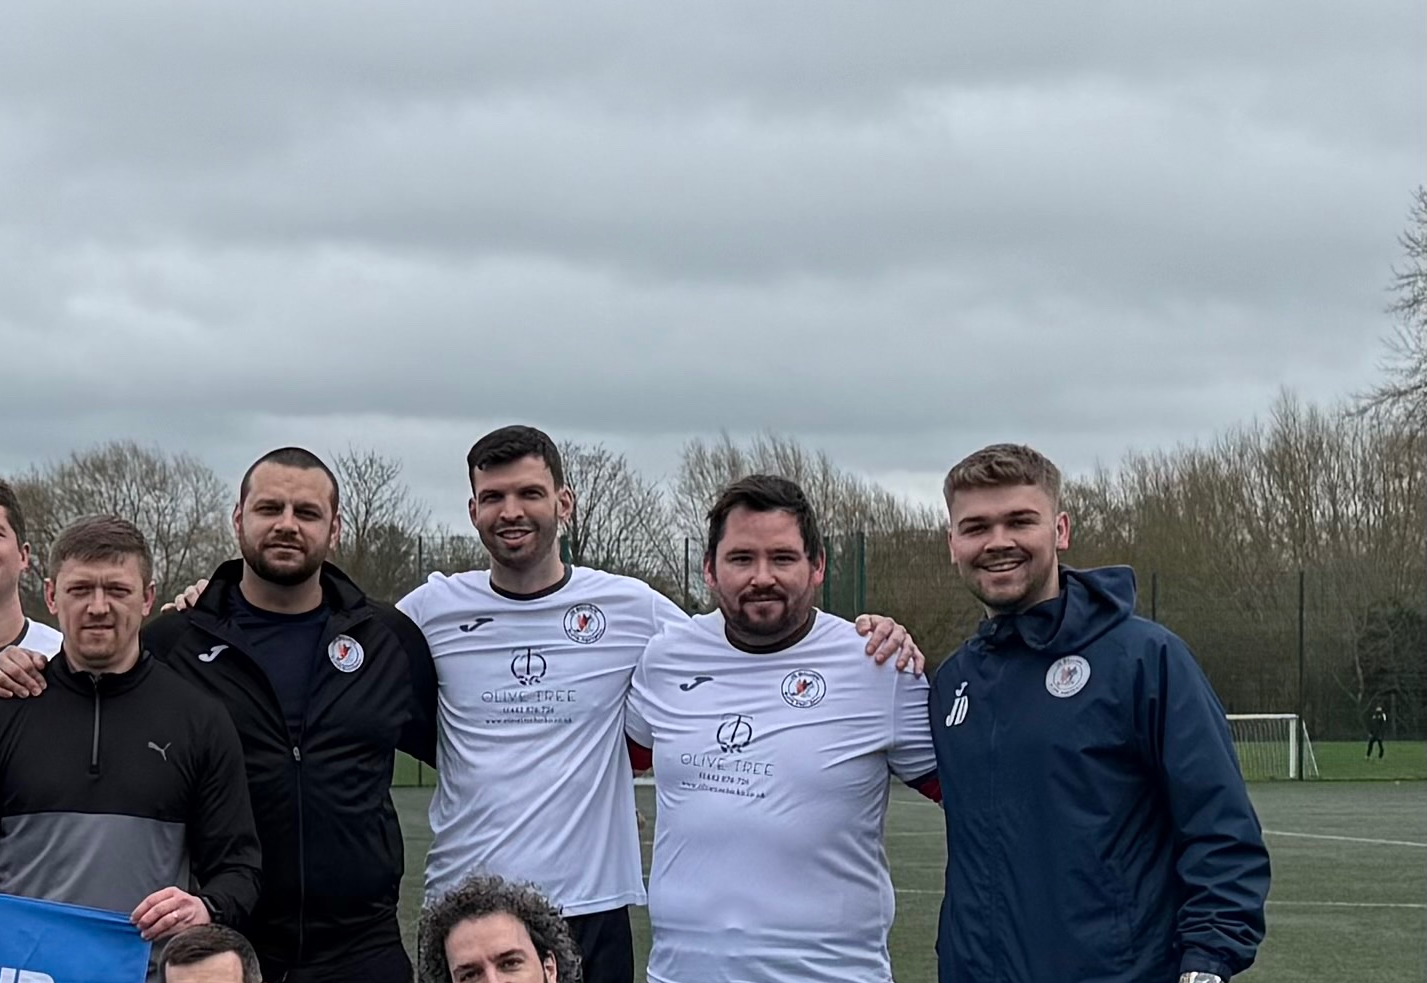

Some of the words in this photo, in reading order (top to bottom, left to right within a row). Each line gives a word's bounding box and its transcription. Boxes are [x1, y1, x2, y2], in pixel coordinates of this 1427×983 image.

[481, 690, 528, 703] OLIVE
[536, 690, 577, 702] TREE
[945, 695, 969, 727] JD
[680, 753, 726, 771] OLIVE
[735, 760, 774, 776] TREE
